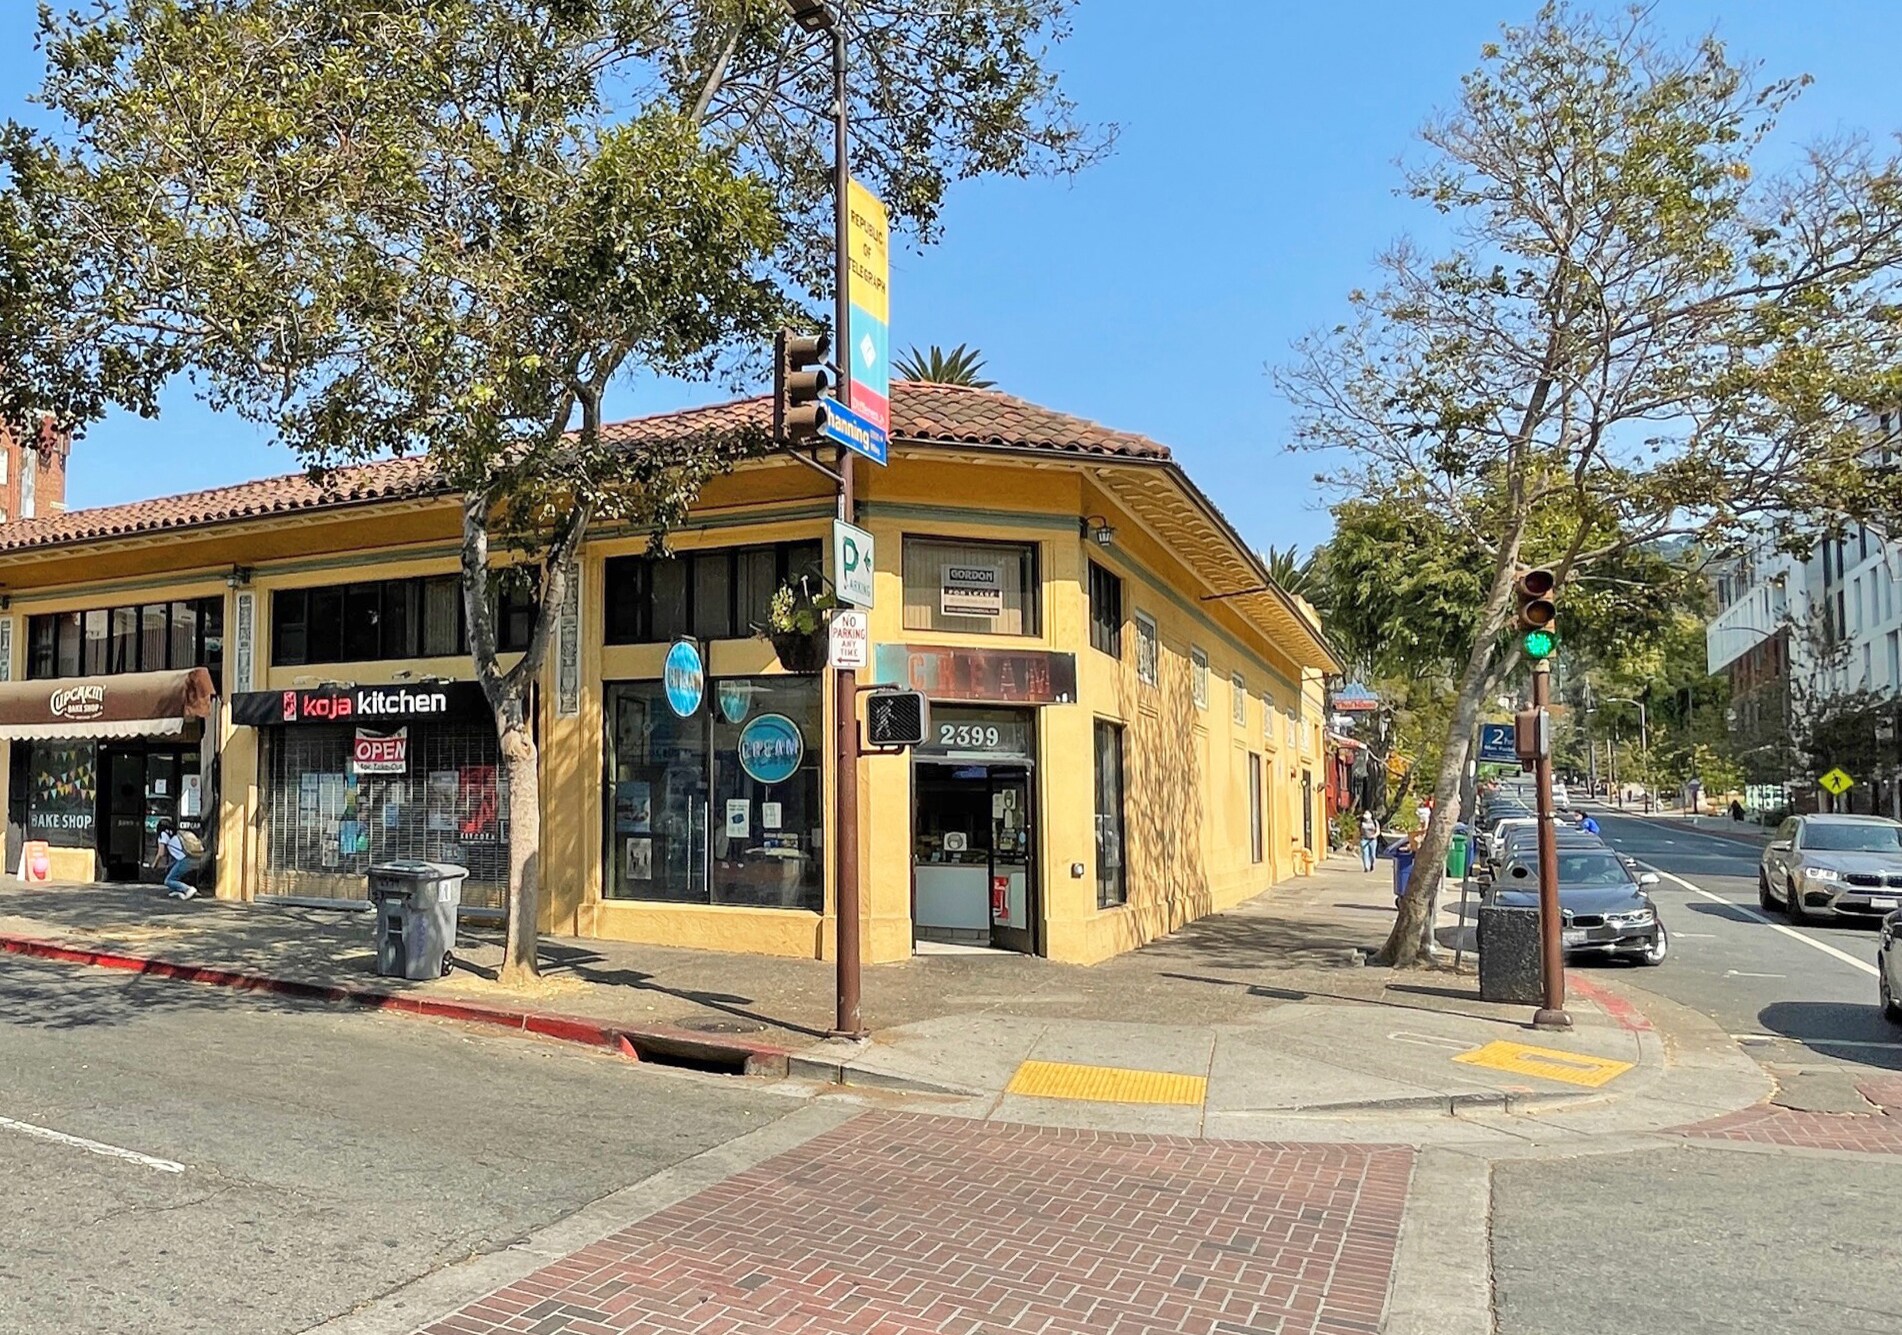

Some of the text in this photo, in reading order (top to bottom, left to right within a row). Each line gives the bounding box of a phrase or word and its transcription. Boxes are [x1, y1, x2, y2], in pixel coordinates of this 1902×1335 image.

[850, 209, 883, 245] REPUBLIC
[863, 243, 872, 259] OF
[848, 256, 886, 295] TELEGRAPH
[820, 402, 870, 451] hanning
[951, 569, 993, 581] GORDON
[842, 616, 856, 627] NO
[832, 628, 865, 640] PARKING
[840, 649, 858, 657] TIME
[841, 641, 856, 650] ANY
[67, 703, 100, 713] BAKE SHOP
[303, 694, 352, 720] koja
[357, 689, 446, 715] kitchen
[940, 724, 999, 747] 2399
[356, 740, 406, 760] OPEN
[31, 814, 93, 830] BAKE SHOP
